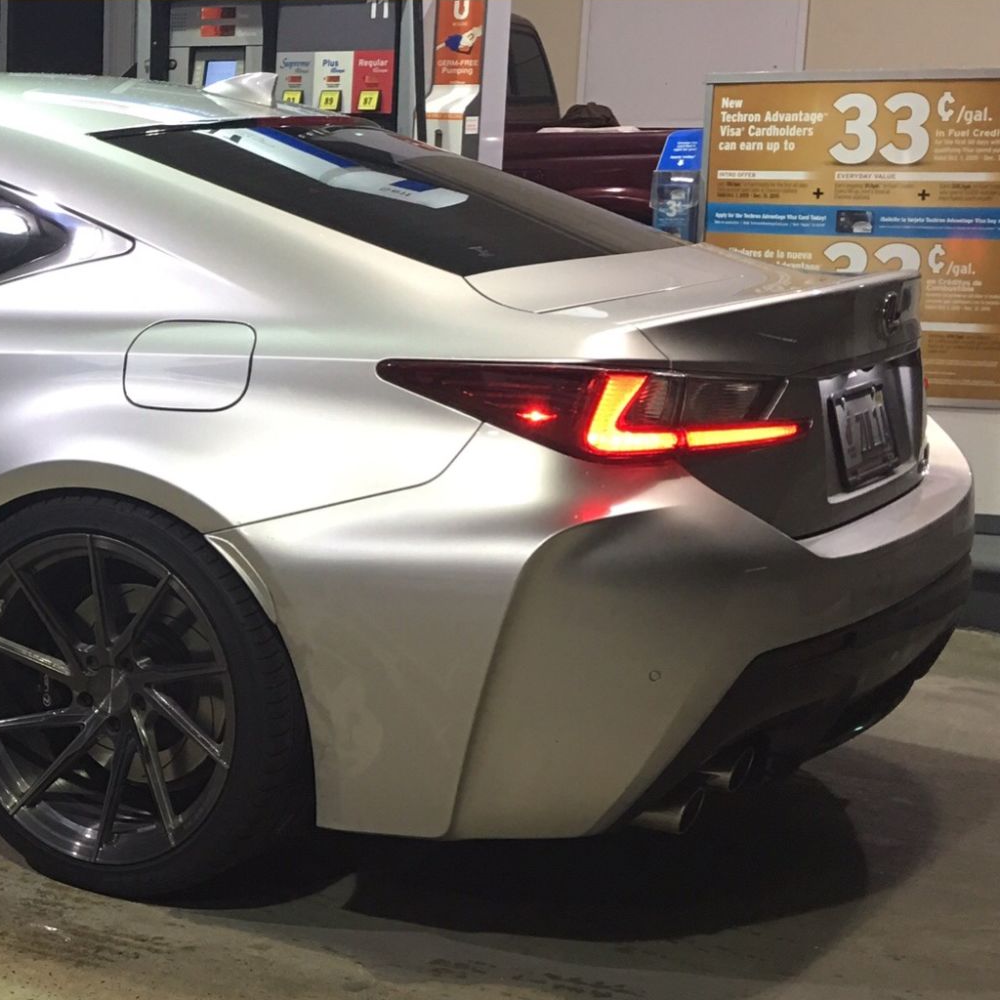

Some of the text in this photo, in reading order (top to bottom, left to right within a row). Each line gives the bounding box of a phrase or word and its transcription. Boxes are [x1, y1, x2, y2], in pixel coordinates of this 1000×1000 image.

[280, 57, 310, 69] Supreme
[322, 59, 338, 67] Plus
[358, 59, 388, 68] Regular
[441, 66, 473, 76] Pumping
[722, 98, 742, 108] New
[721, 111, 761, 122] Techron
[748, 125, 813, 136] Cardholders
[948, 129, 970, 137] Fuel
[719, 139, 795, 153] can earn up to
[764, 248, 774, 258] de
[776, 249, 785, 258] la
[786, 251, 813, 260] nueva
